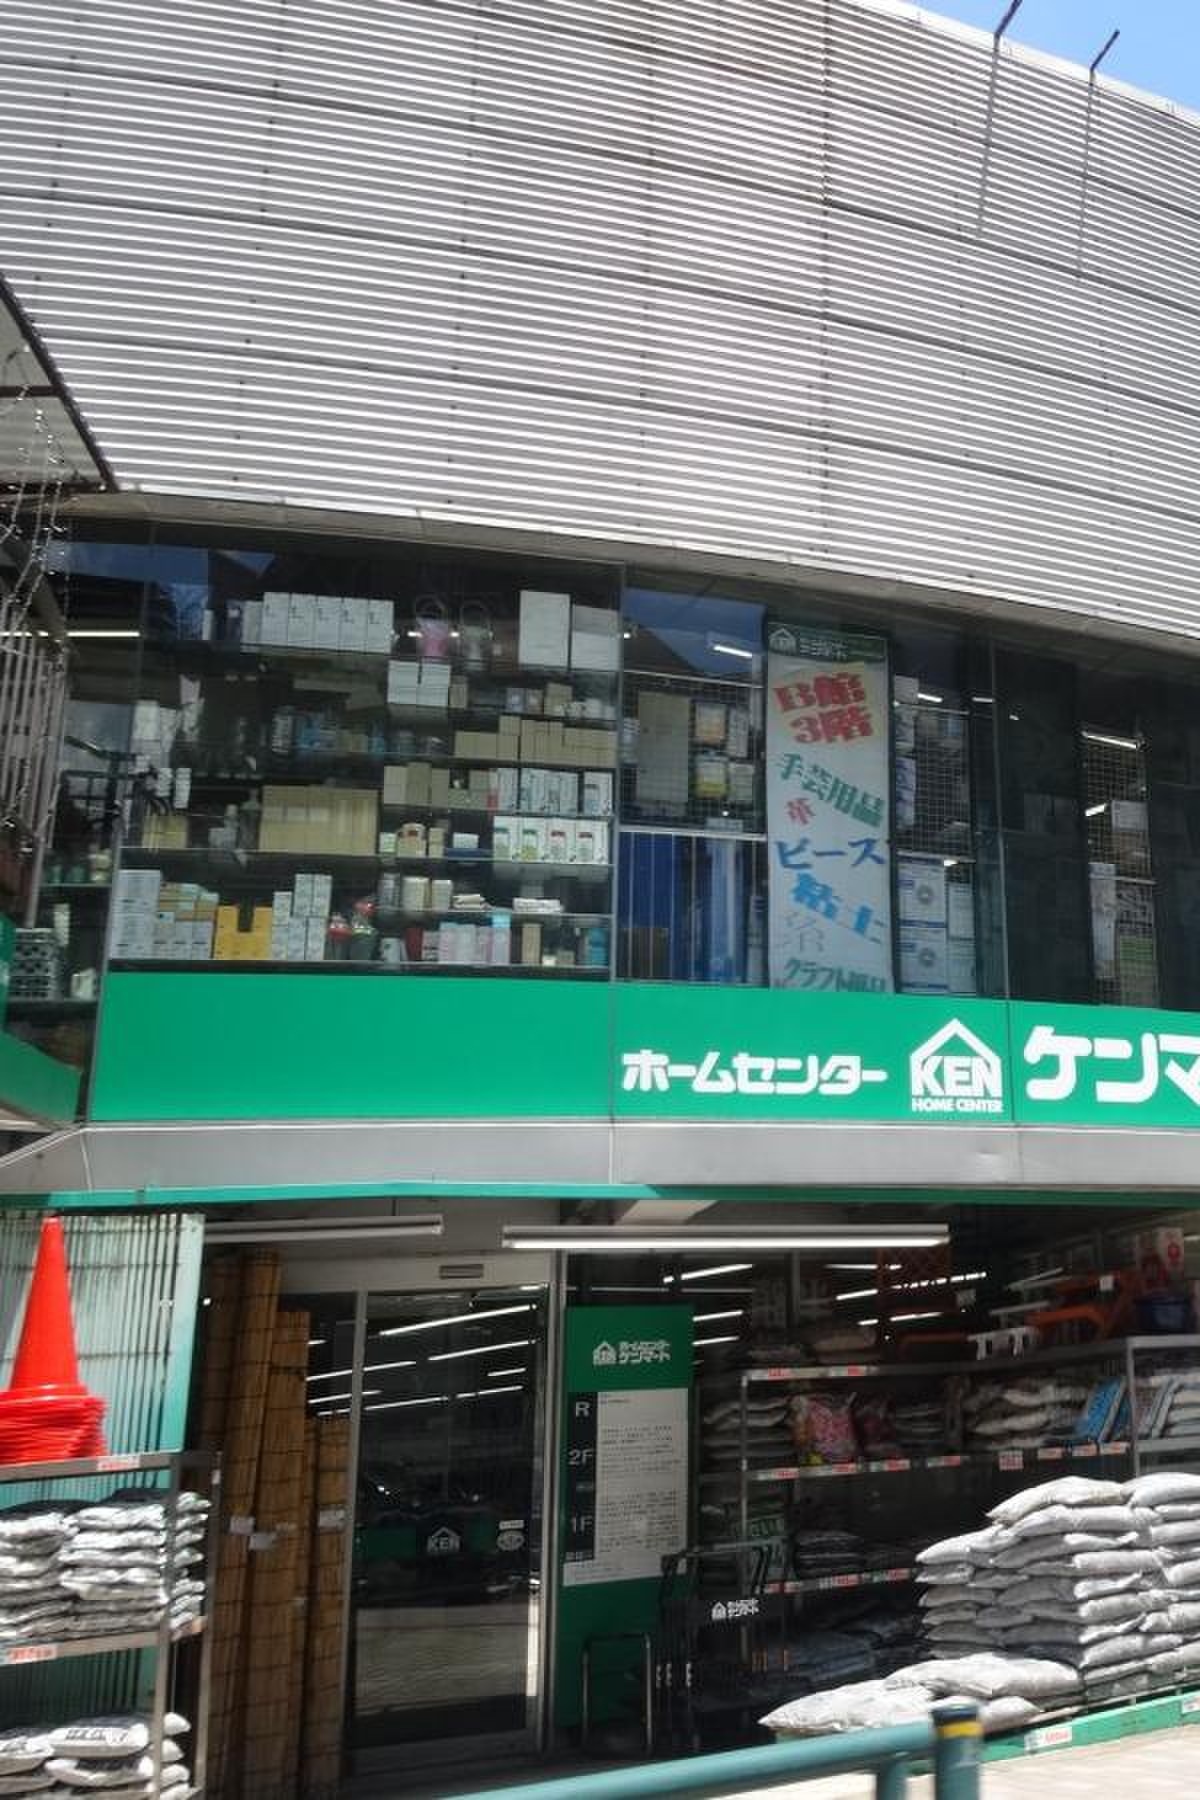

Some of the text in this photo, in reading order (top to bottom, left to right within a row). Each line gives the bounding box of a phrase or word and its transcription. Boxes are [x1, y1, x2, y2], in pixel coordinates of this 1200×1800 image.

[622, 1049, 888, 1095] ホームセンター
[911, 1055, 1002, 1097] KEN
[911, 1098, 1004, 1114] HOME CENTER
[575, 1402, 590, 1418] R
[569, 1450, 593, 1467] 2F
